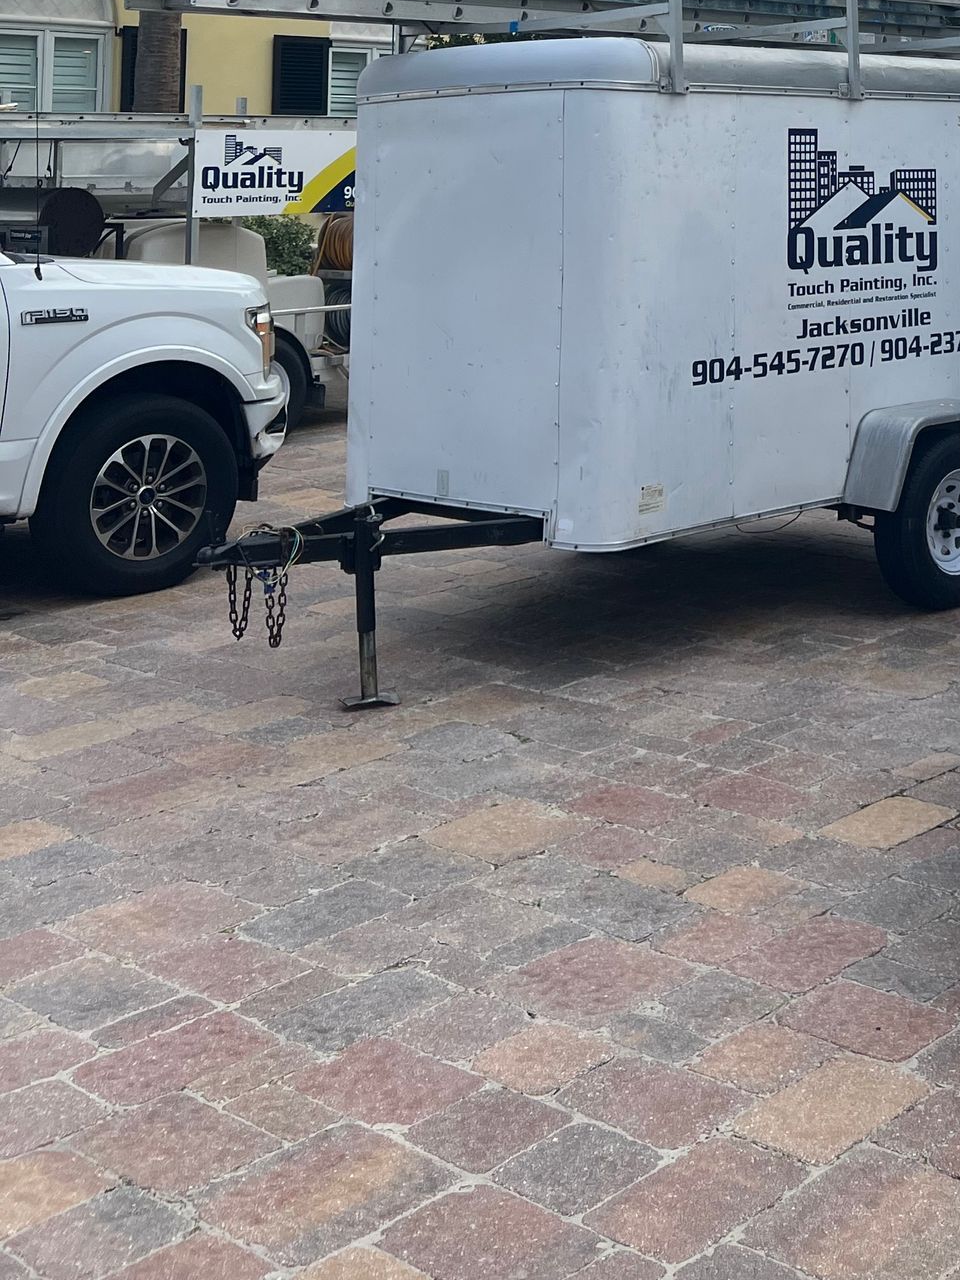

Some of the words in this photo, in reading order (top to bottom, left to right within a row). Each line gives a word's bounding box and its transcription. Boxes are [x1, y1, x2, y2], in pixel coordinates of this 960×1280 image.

[201, 166, 303, 193] Quality
[202, 196, 232, 204] Touch
[236, 195, 281, 204] Painting,
[285, 194, 302, 202] Inc.
[787, 223, 938, 274] Quality
[788, 281, 834, 297] Touch
[840, 276, 907, 293] Painting,
[912, 273, 938, 287] Inc.
[875, 294, 908, 303] Restoration
[910, 291, 937, 300] Specialist
[796, 308, 931, 340] Jacksonville
[692, 342, 865, 386] 904-545-7270
